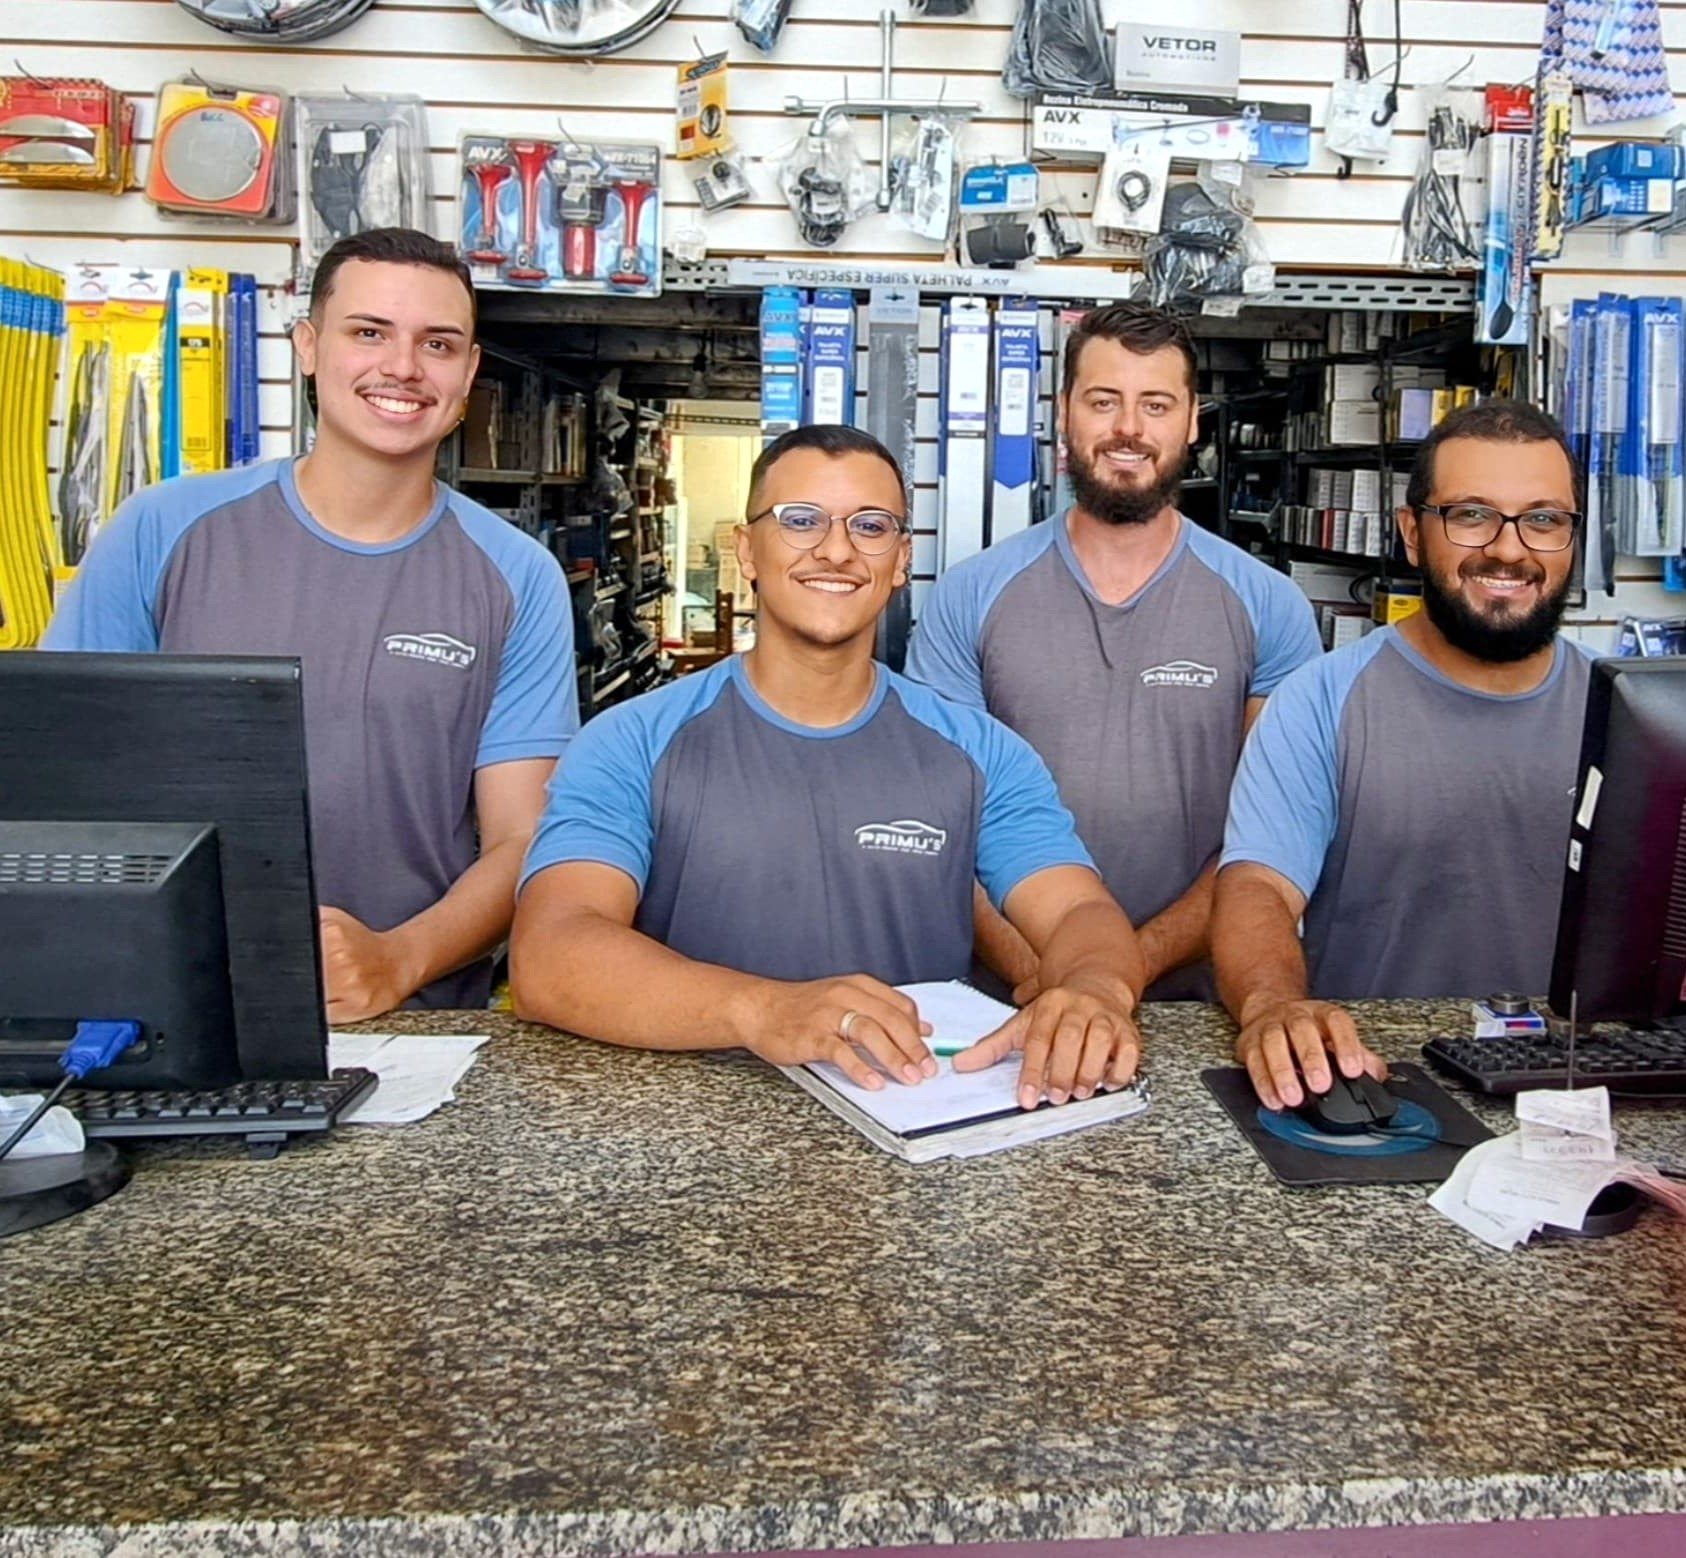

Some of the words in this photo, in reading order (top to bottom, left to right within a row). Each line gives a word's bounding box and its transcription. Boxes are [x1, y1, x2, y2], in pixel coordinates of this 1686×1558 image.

[1142, 35, 1217, 52] VETOR
[1043, 109, 1081, 124] AVX
[467, 145, 505, 160] AVX
[787, 269, 861, 283] ESPECÍFICA
[864, 272, 909, 285] SUPER
[912, 274, 972, 287] PALHETA
[1644, 312, 1680, 324] AVX
[814, 325, 846, 337] AVX
[1002, 328, 1032, 338] AVX
[858, 831, 942, 852] PRIMU'S
